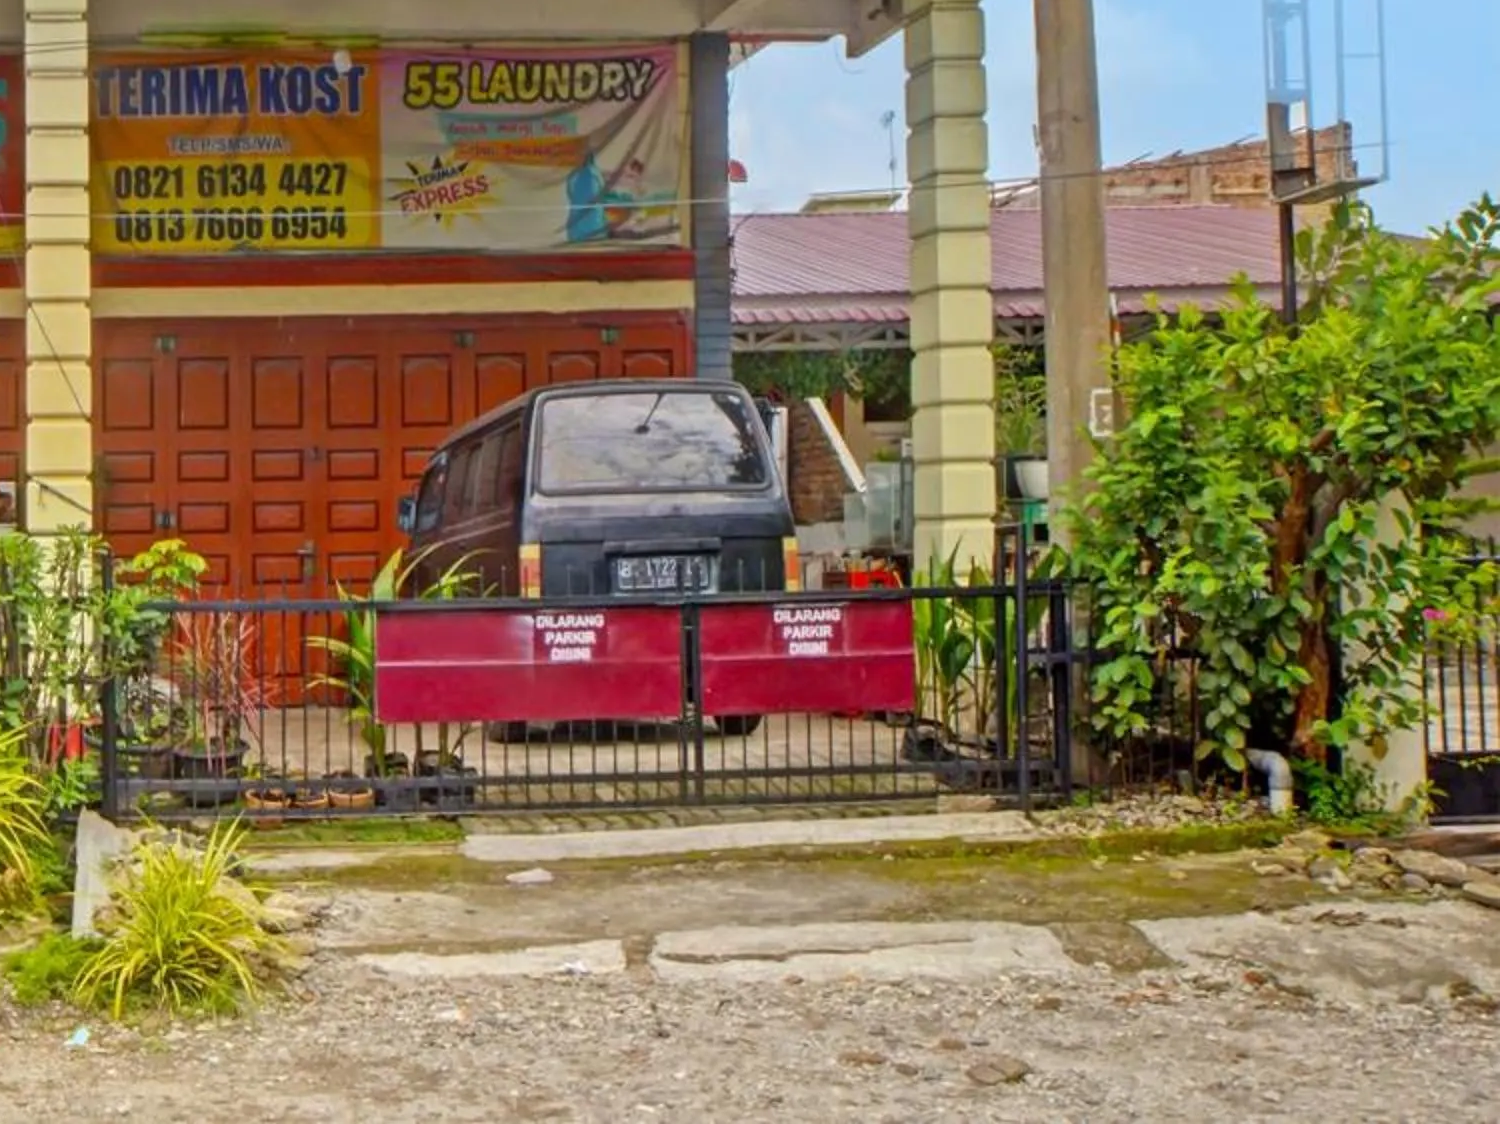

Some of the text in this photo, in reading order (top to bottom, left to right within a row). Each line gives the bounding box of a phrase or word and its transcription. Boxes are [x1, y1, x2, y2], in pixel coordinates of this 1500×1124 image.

[95, 62, 369, 117] TERIMA KOST
[404, 58, 658, 109] 55 LAUNDRY
[114, 162, 348, 199] 0821 6134 4427
[400, 174, 490, 213] EXPRESS
[115, 207, 347, 243] 0813 7666 6954
[536, 614, 605, 629] DILARANG
[772, 608, 841, 623] DILARANG
[783, 625, 833, 639] PARKIR
[544, 631, 596, 645] PARKIR
